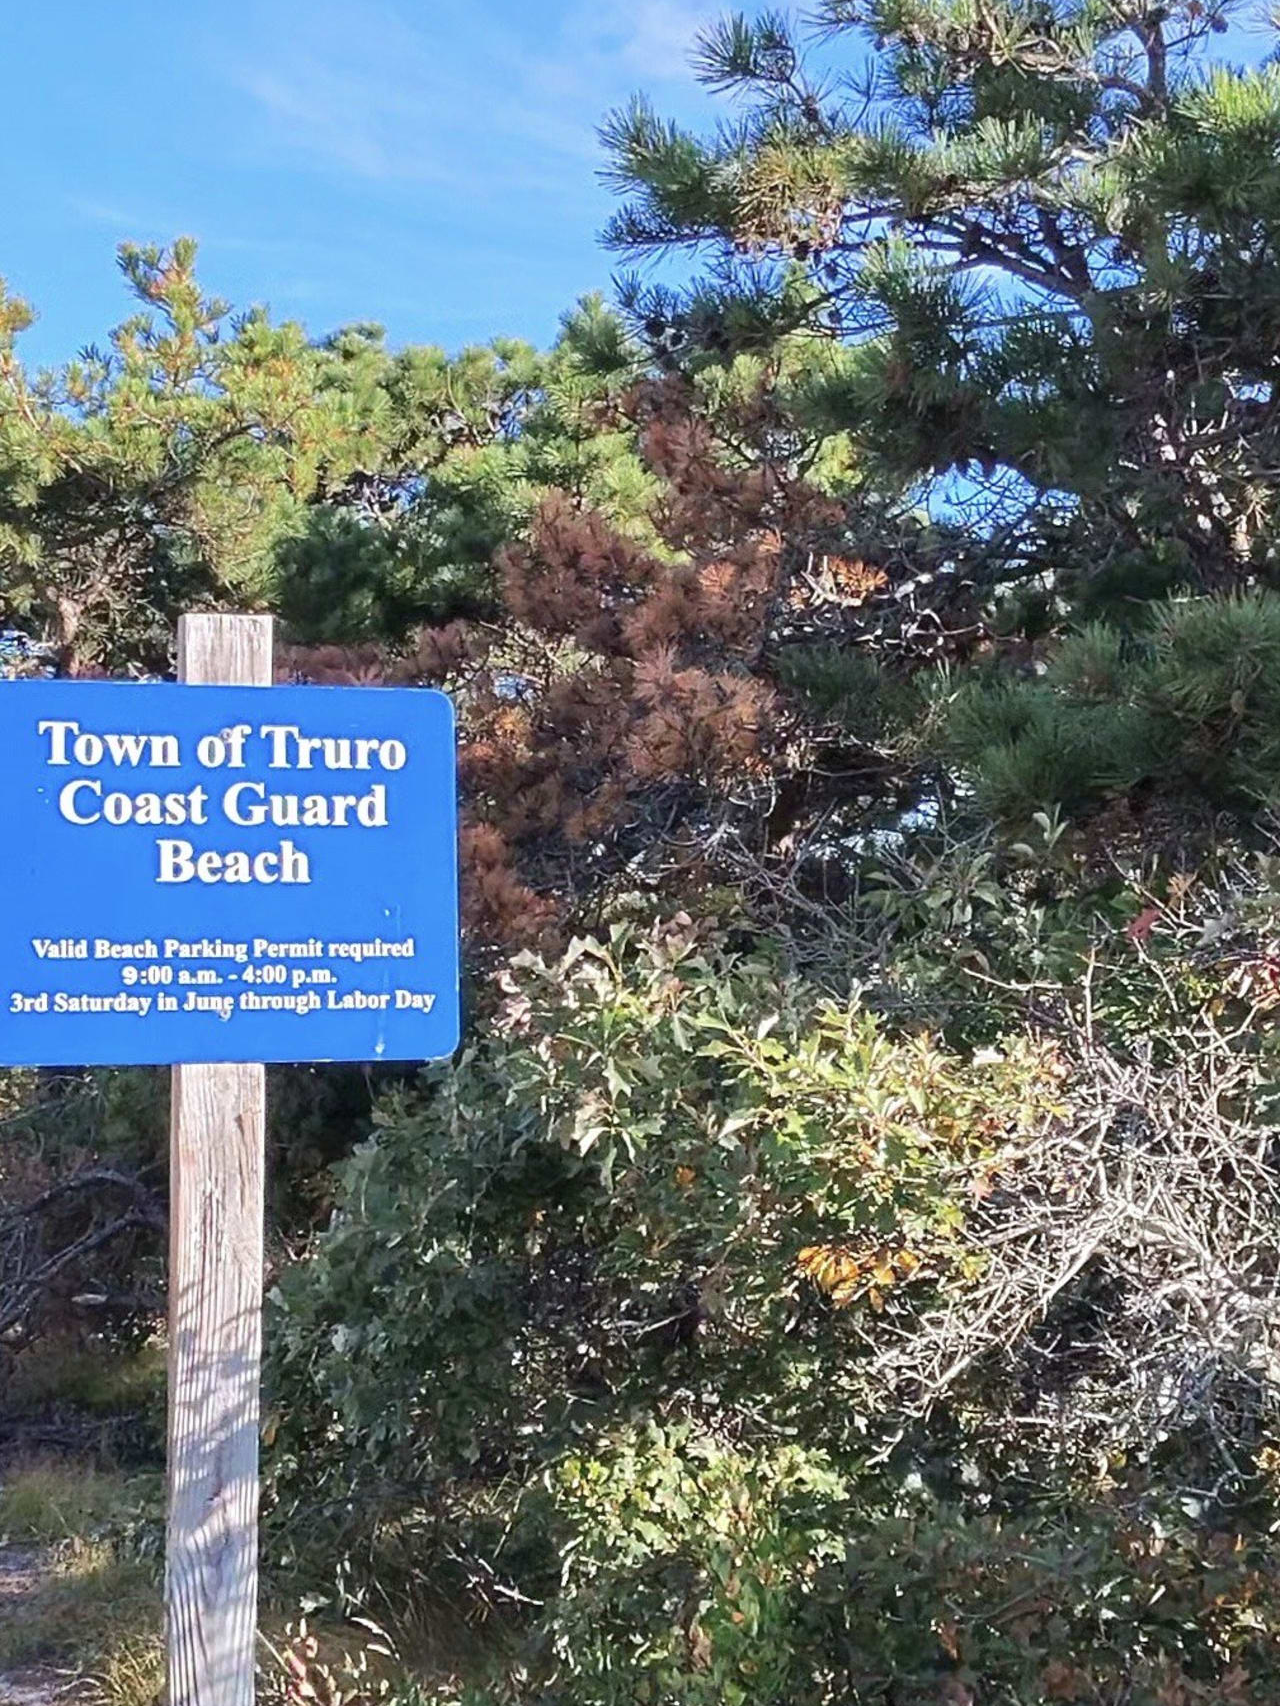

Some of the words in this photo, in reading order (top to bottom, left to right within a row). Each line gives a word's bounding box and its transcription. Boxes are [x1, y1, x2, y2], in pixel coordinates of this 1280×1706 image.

[39, 721, 180, 766] Town
[197, 725, 251, 767] of
[261, 725, 405, 770] Truro
[60, 780, 208, 825] Coast
[223, 782, 388, 826] Guard
[156, 840, 311, 883] Beach
[32, 939, 87, 958] Valid
[95, 939, 158, 958] Beach
[164, 939, 248, 962] Parking
[254, 939, 323, 957] Permit
[329, 939, 414, 961] required
[122, 966, 173, 985] 9:00
[179, 970, 222, 984] a.m.
[242, 965, 287, 983] 4:00
[292, 970, 337, 988] p.m.
[10, 993, 48, 1012] 3rd
[54, 993, 151, 1015] Saturday
[158, 993, 178, 1010] in
[183, 992, 234, 1012] June
[240, 991, 321, 1014] through
[328, 990, 390, 1009] Labor
[395, 990, 435, 1013] Day
